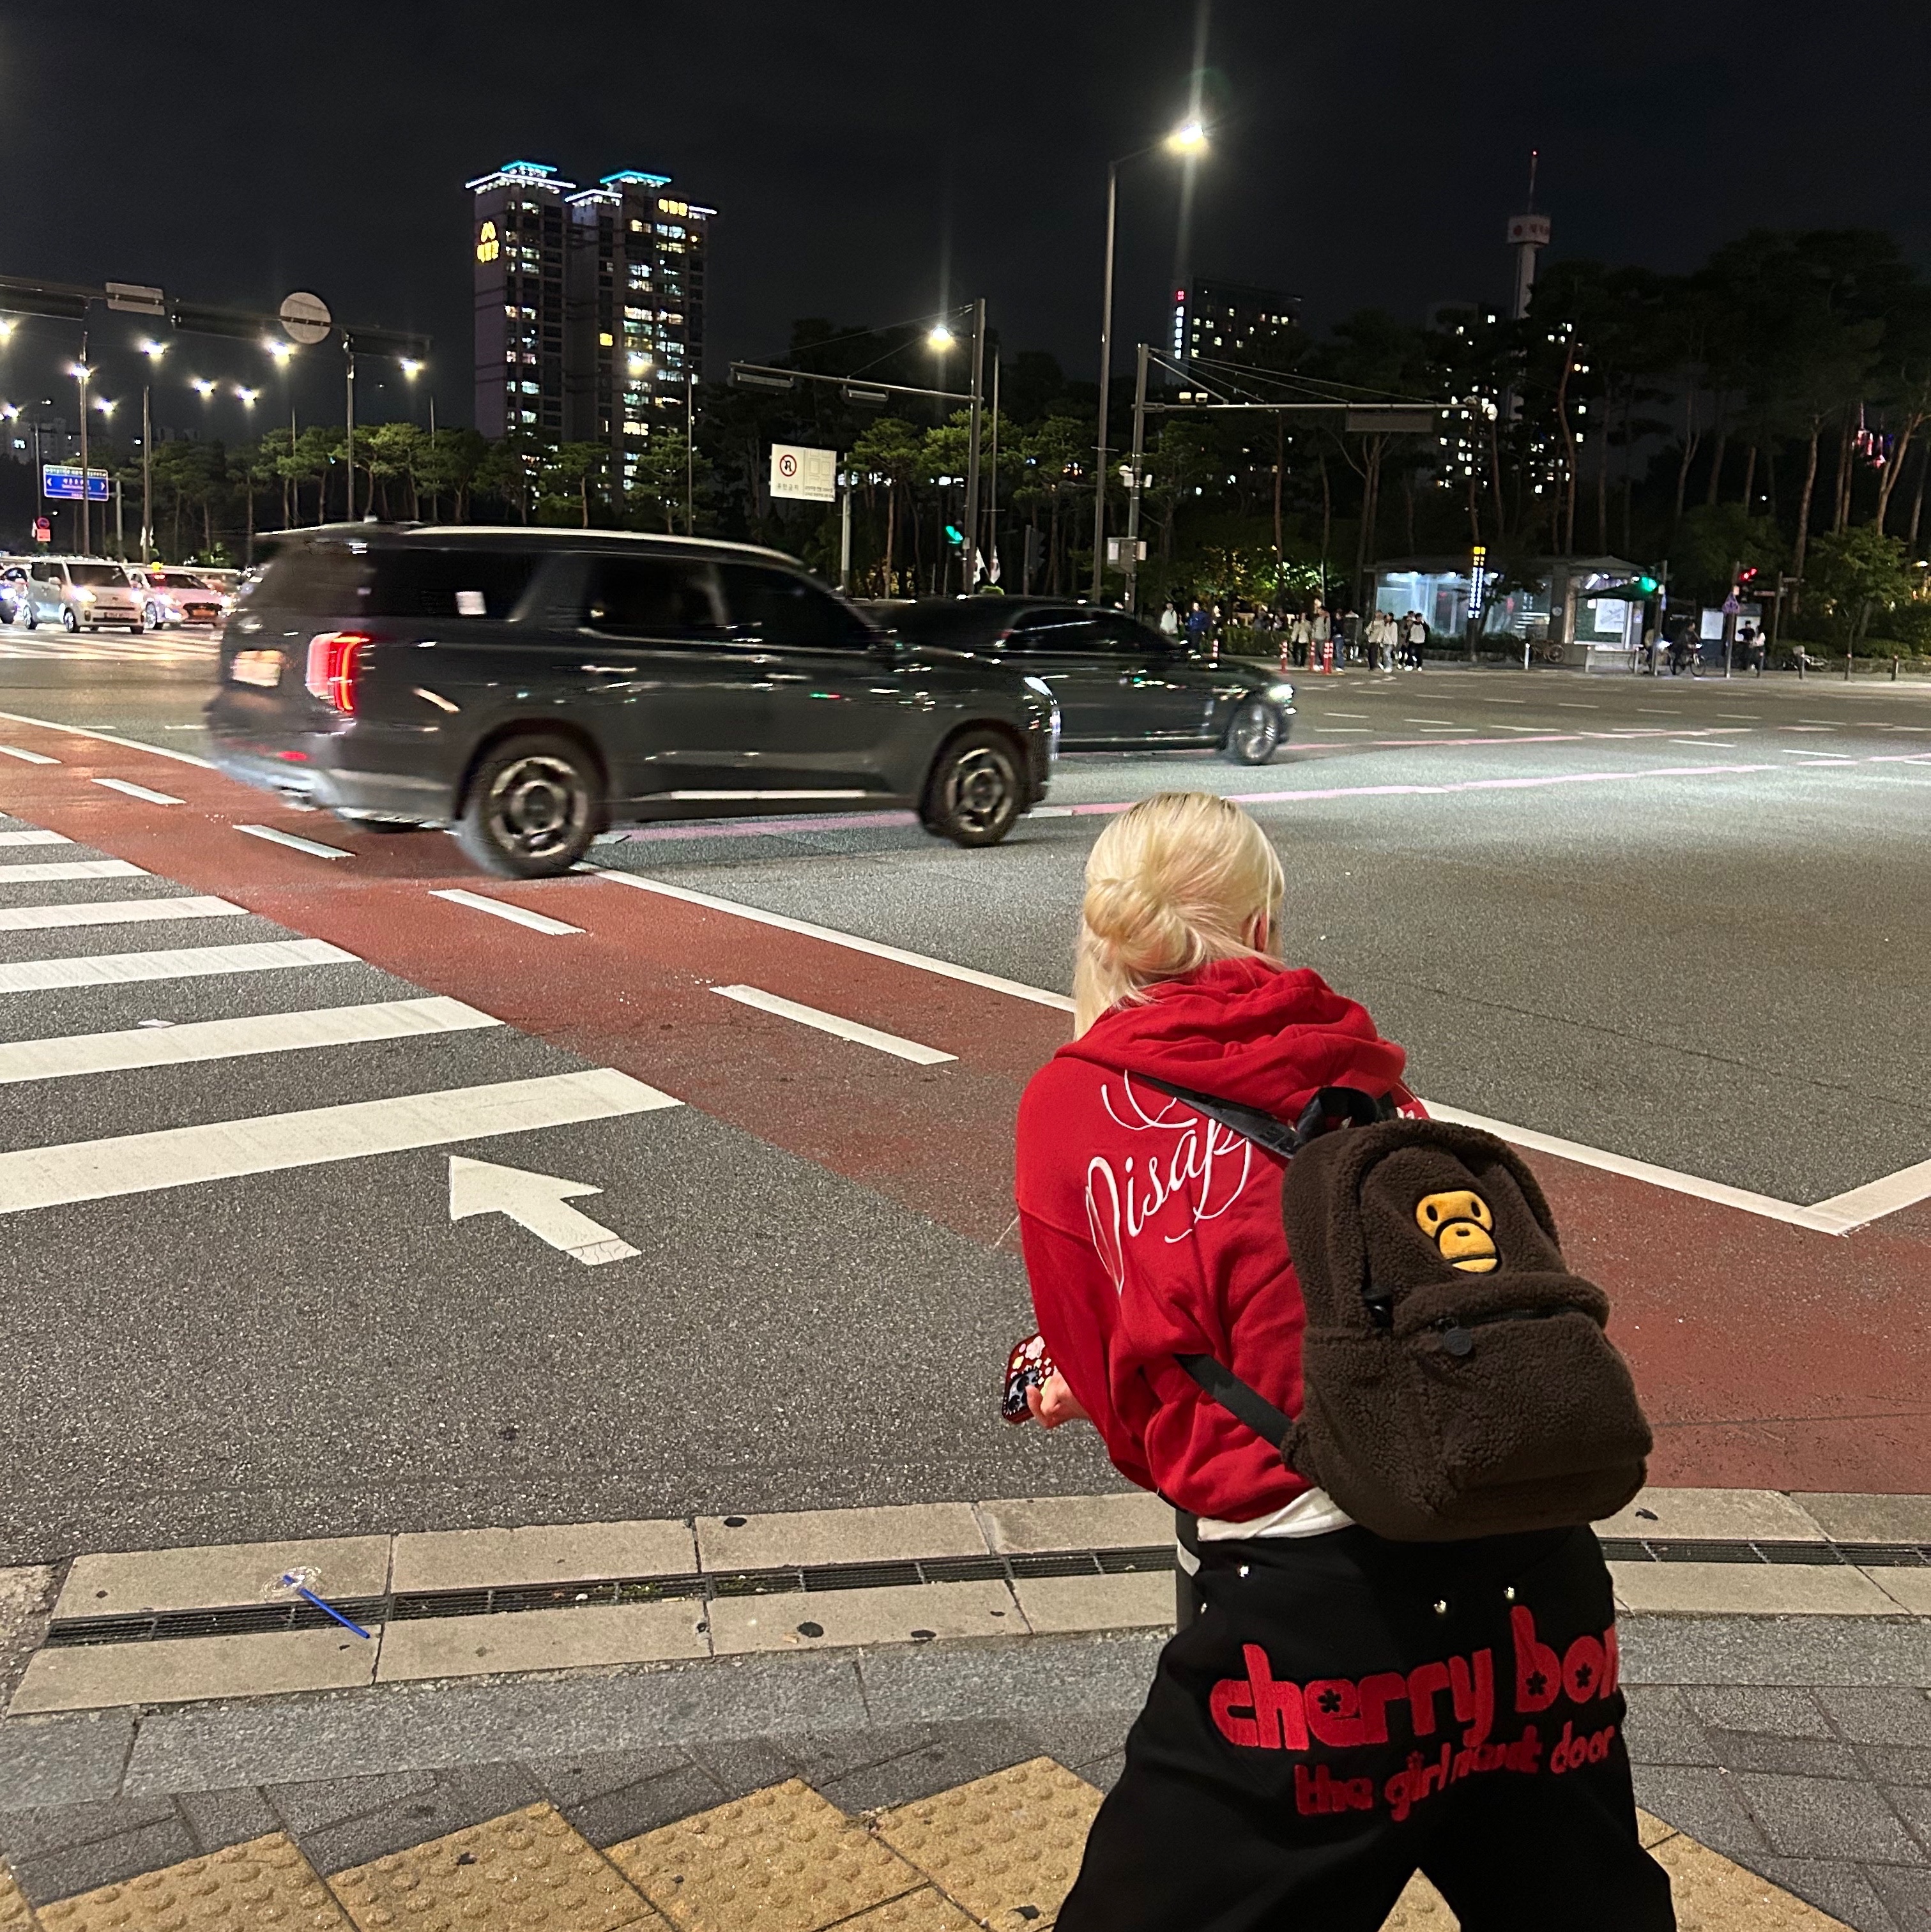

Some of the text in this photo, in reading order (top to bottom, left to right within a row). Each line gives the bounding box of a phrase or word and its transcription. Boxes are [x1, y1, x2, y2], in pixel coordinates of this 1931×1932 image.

[1209, 1643, 1493, 1750] cherry
[1294, 1764, 1373, 1815] the
[1384, 1742, 1451, 1822] girl
[1550, 1719, 1615, 1774] door
